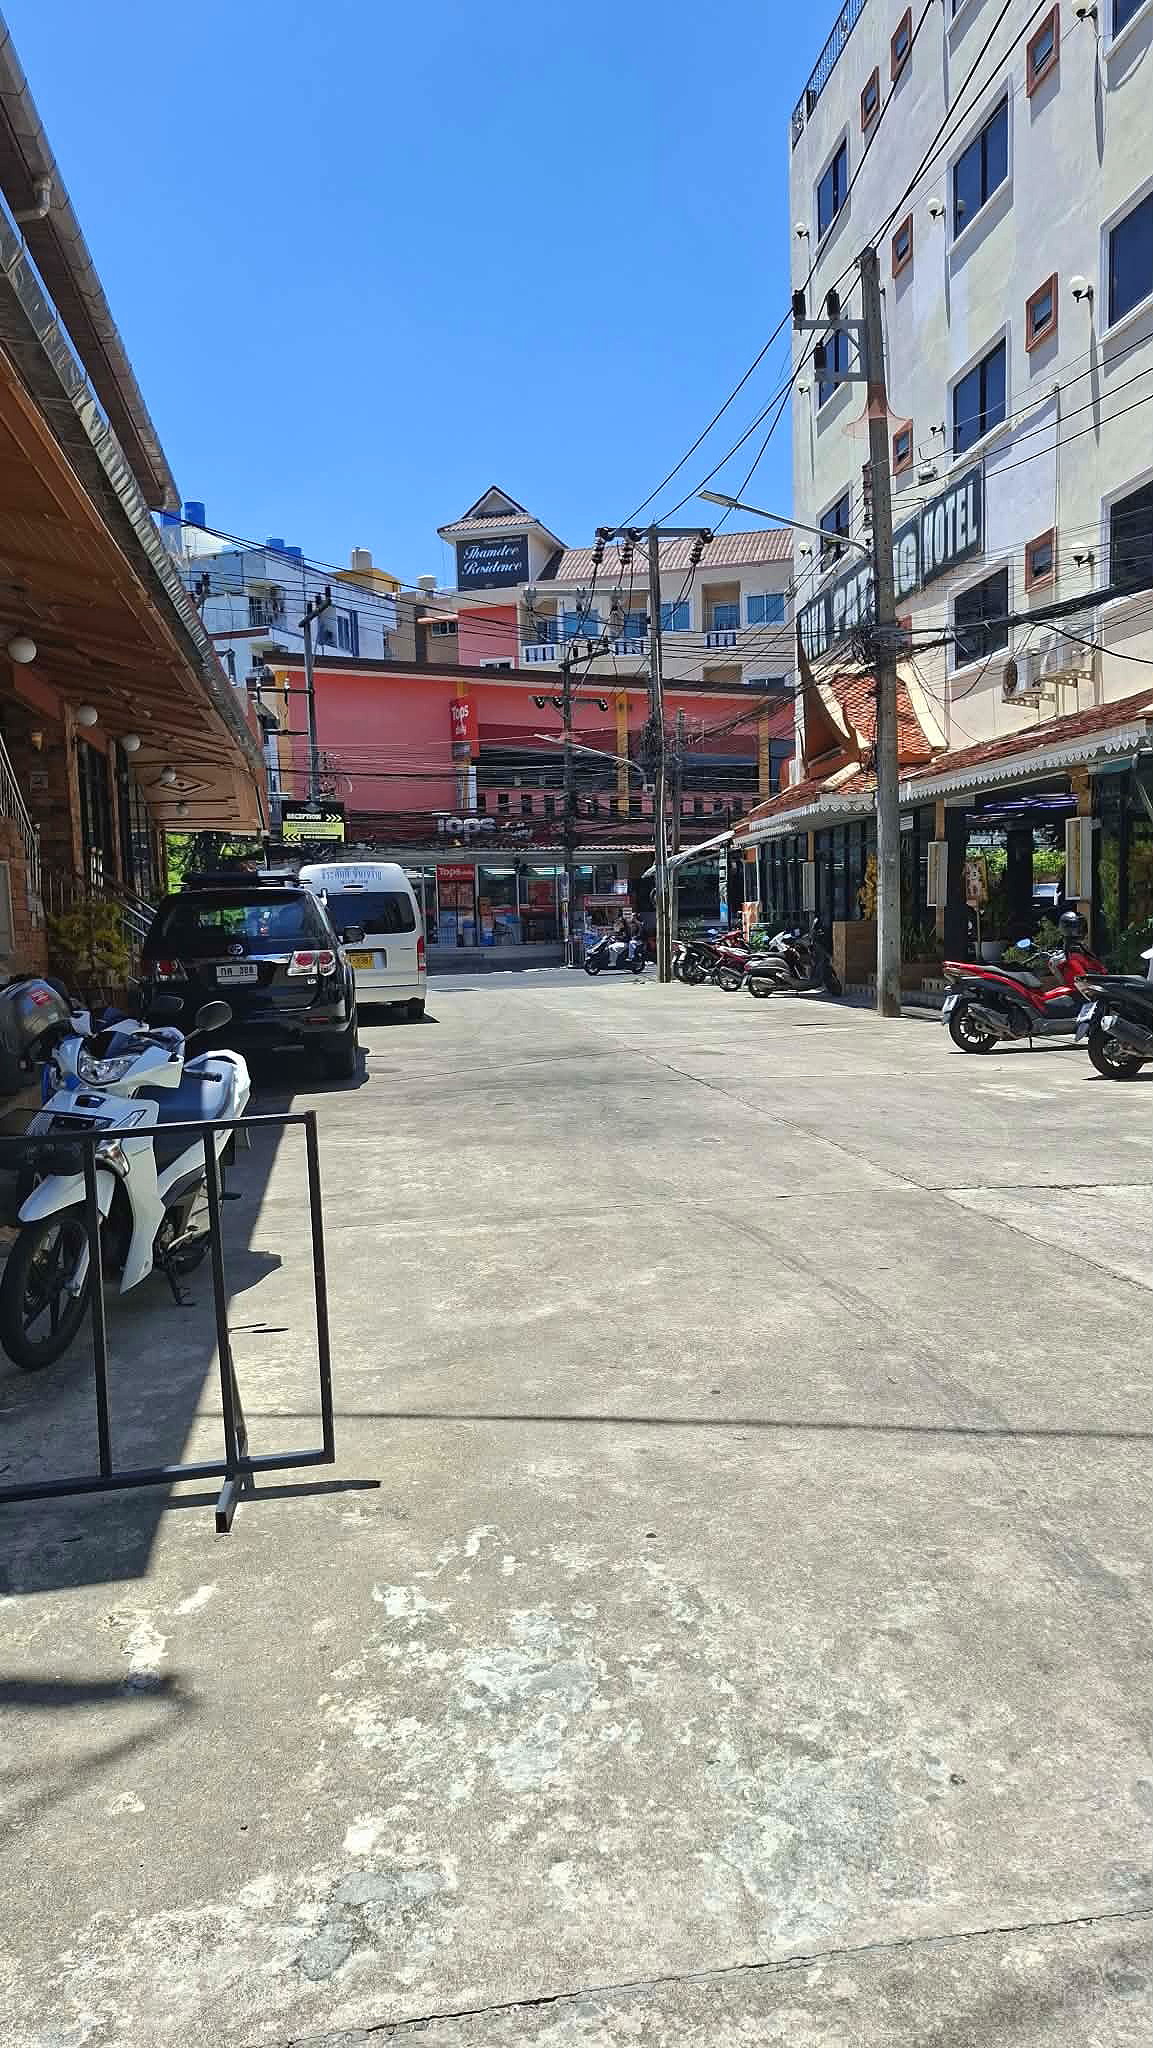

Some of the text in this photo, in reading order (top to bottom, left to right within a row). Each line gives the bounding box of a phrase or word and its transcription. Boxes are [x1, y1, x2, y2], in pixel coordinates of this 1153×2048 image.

[923, 480, 978, 576] HOTEL
[461, 560, 522, 576] Residence
[451, 704, 470, 729] Tops
[438, 867, 461, 878] Tops
